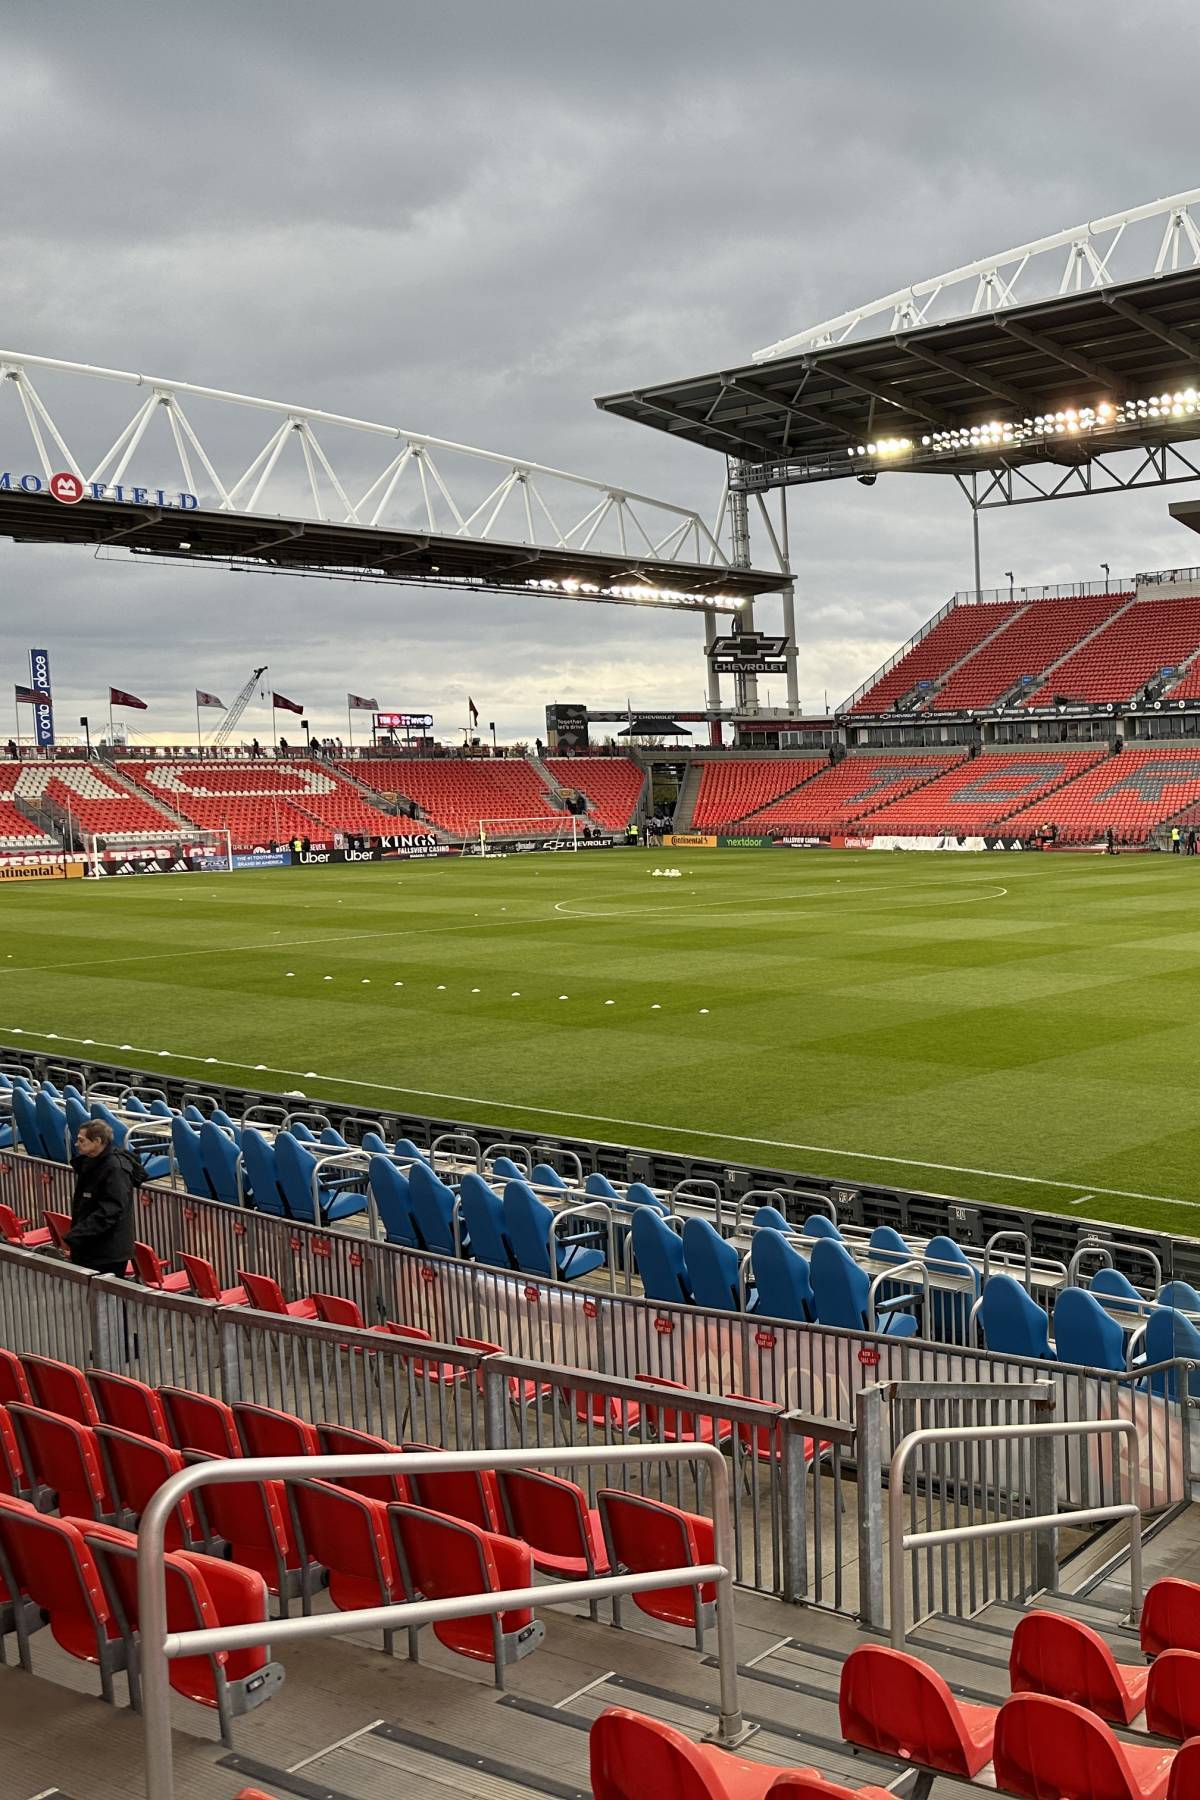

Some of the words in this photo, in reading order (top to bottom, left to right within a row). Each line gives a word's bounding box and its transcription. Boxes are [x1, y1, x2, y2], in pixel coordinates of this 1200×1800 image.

[91, 483, 199, 511] FIELD
[33, 655, 50, 688] place
[714, 663, 785, 672] CHEVROLET
[557, 719, 583, 727] Together
[380, 833, 437, 848] KINGS
[726, 837, 762, 847] nextdoor
[344, 850, 374, 861] Uber
[398, 846, 428, 855] FALLSVIEW
[429, 845, 450, 853] CASINO
[300, 852, 330, 864] Uber
